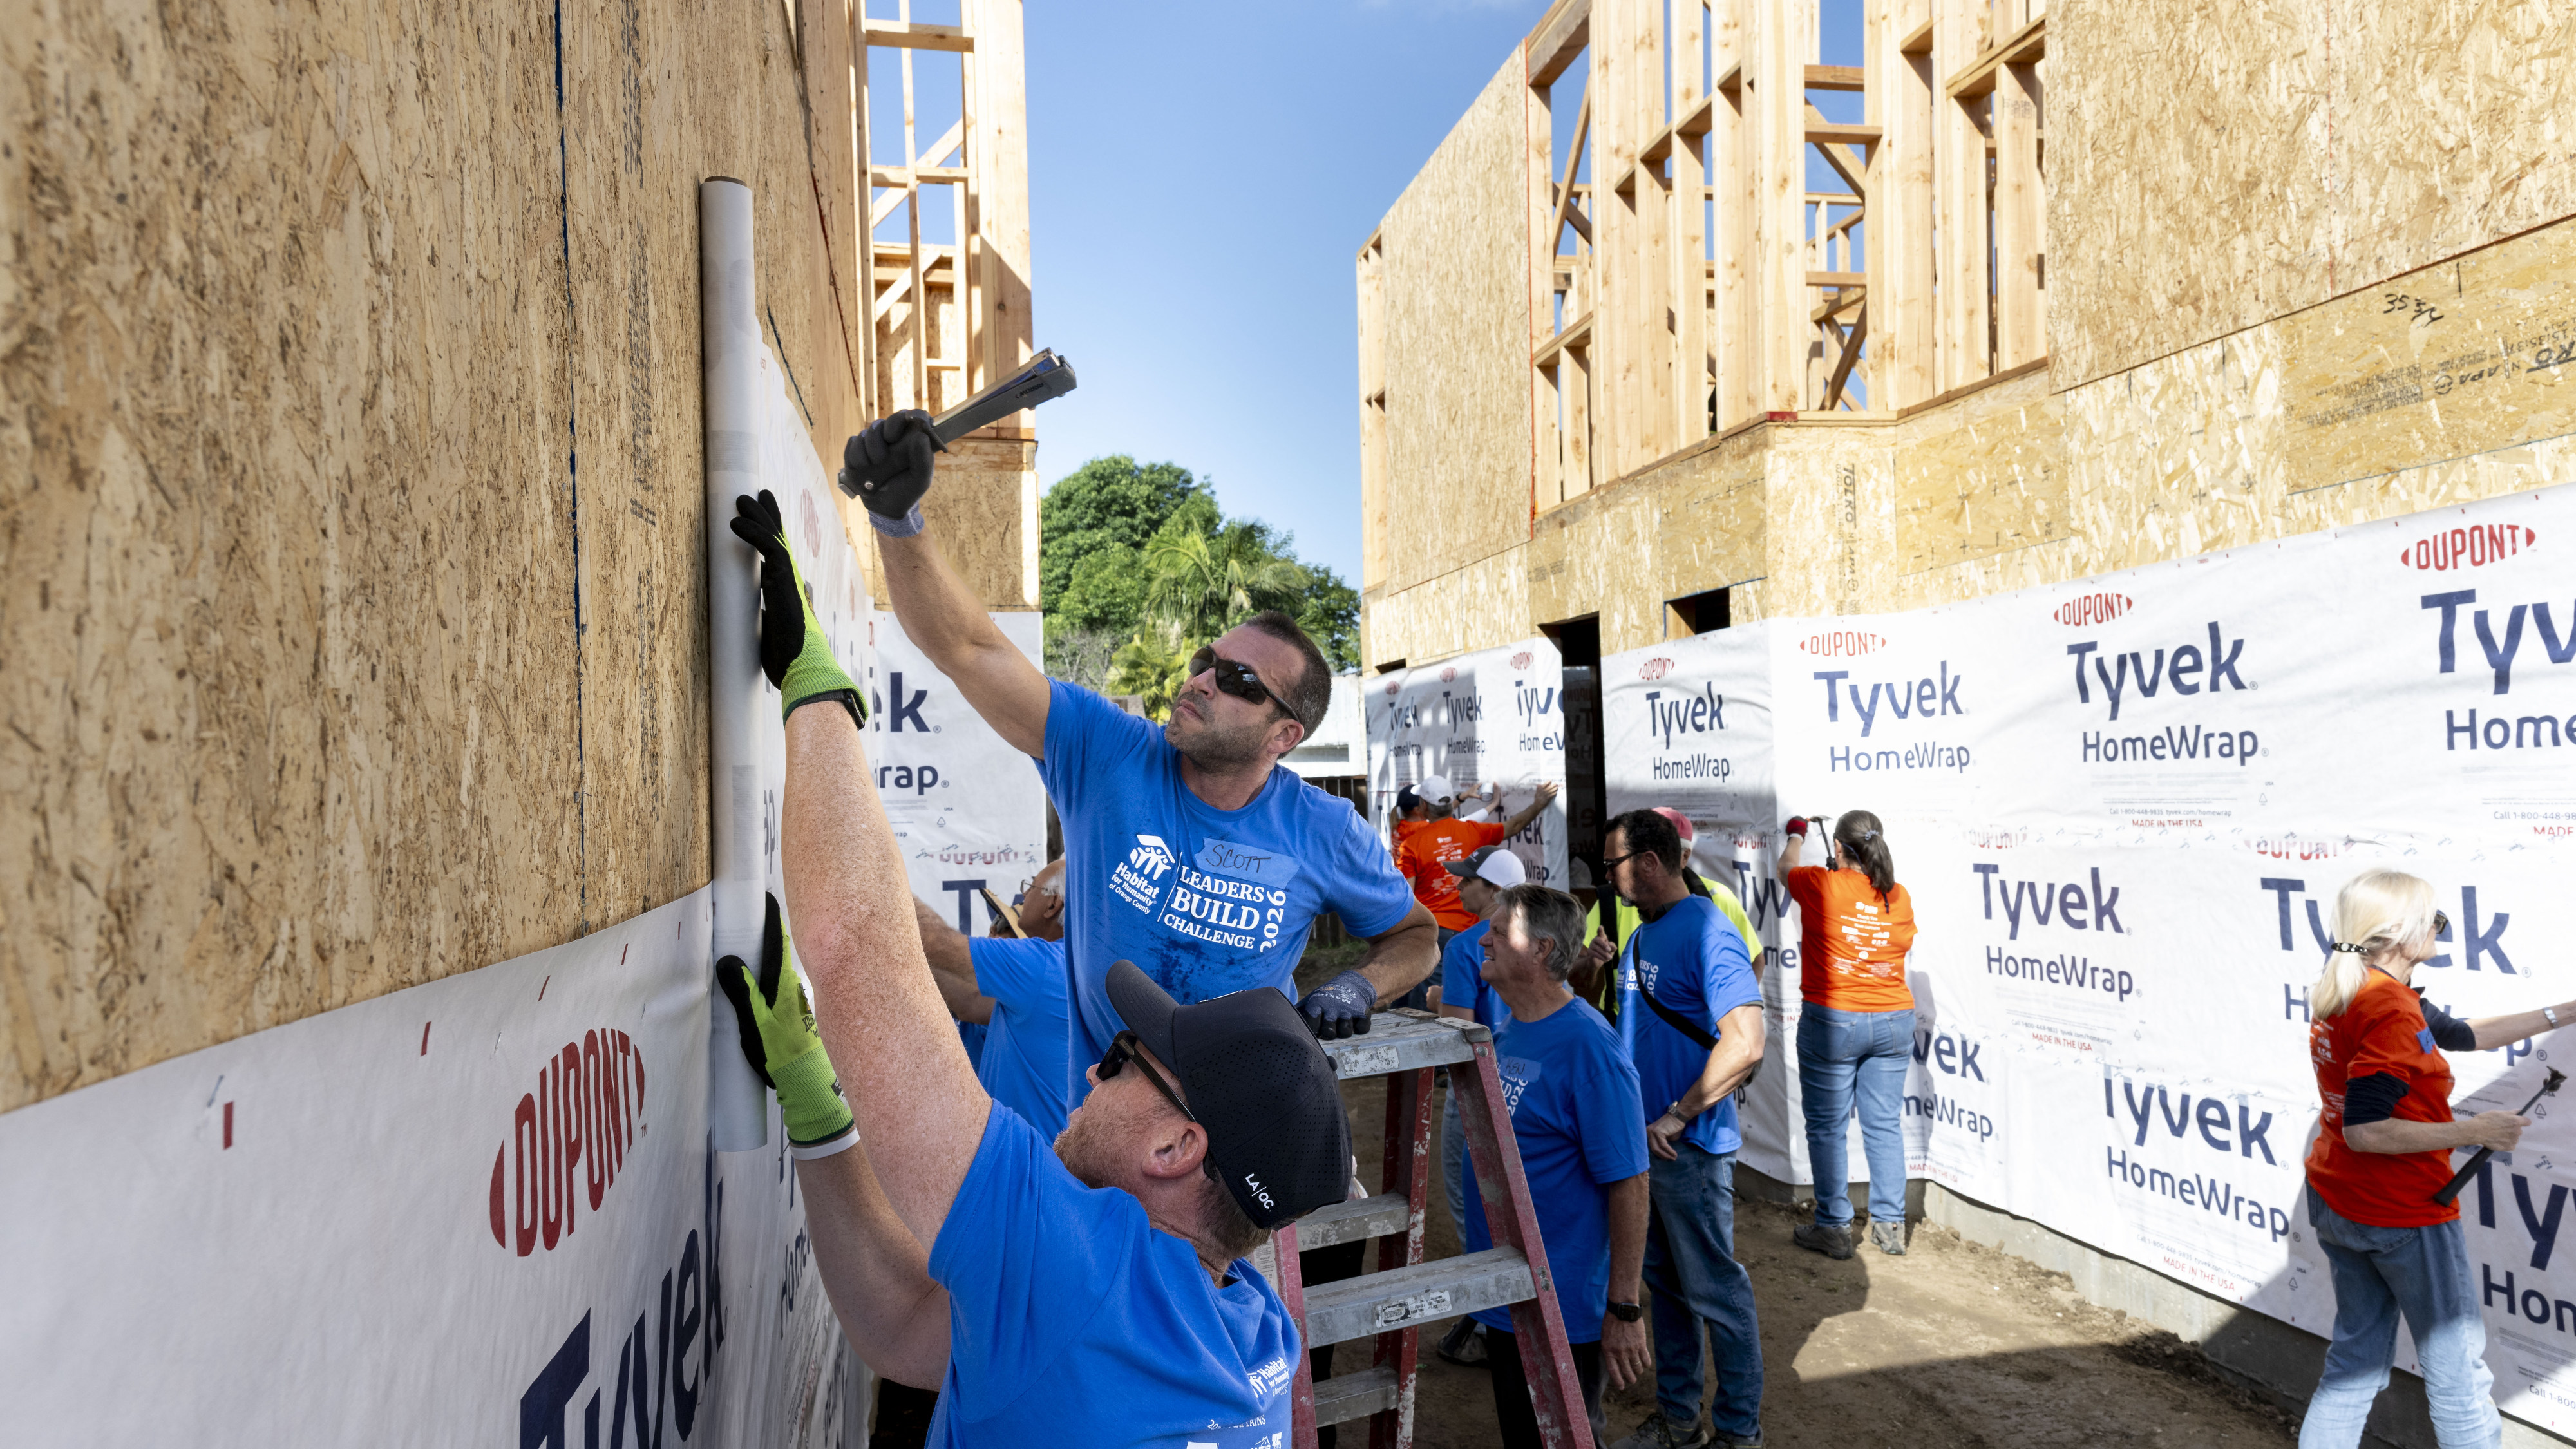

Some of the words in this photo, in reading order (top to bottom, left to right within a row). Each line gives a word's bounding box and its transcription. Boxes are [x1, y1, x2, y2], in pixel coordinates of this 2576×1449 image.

[2460, 365, 2501, 384] APA
[1844, 466, 1855, 523] TOLKO
[2416, 524, 2519, 571] DUPONT
[2063, 593, 2123, 627] DUPONT
[1810, 631, 1877, 656] DUPONT
[2421, 589, 2576, 696] Tyv
[1642, 658, 1671, 681] DUPONT
[2067, 620, 2248, 721] Tyvek
[1443, 686, 1482, 733] Tyvek
[1646, 681, 1724, 749] Tyvek
[1814, 660, 1963, 737] Tyvek
[1388, 696, 1419, 739] Tyvek
[1448, 737, 1485, 757] HomeWrap
[1830, 741, 1970, 773] HomeWrap
[2083, 724, 2259, 766] HomeWrap
[876, 764, 938, 795] rap
[1653, 753, 1730, 782] HomeWrap
[2132, 819, 2154, 828] MADE
[2157, 819, 2165, 828] IN
[2167, 819, 2184, 828] THE
[1206, 844, 1271, 873] SCOTT
[1112, 873, 1122, 884] for
[1122, 881, 1153, 907] Humanity
[1115, 862, 1159, 898] Habitat
[1180, 866, 1264, 902] LEADERS
[1732, 860, 1793, 931] Tyv
[1115, 887, 1132, 902] Orange
[1132, 900, 1151, 914] County
[1171, 886, 1260, 930] BUILD
[1973, 863, 2124, 940] Tyvek
[1164, 913, 1255, 949] CHALLENGE
[1260, 891, 1286, 953] 2026
[1986, 945, 2134, 1002] HomeWrap
[2032, 1032, 2052, 1044] MADE
[2054, 1037, 2061, 1046] IN
[2063, 1038, 2076, 1049] THE
[2078, 1042, 2092, 1052] USA
[515, 1028, 632, 1256] DUPONT
[2107, 1146, 2290, 1242] HomeWrap
[2137, 1234, 2146, 1244] Call
[2163, 1256, 2186, 1273] MADE
[2189, 1266, 2197, 1276] IN
[2199, 1269, 2215, 1284] THE
[2217, 1278, 2235, 1291] USA
[1257, 1356, 1287, 1379] Habitat
[2529, 1384, 2546, 1401] Call
